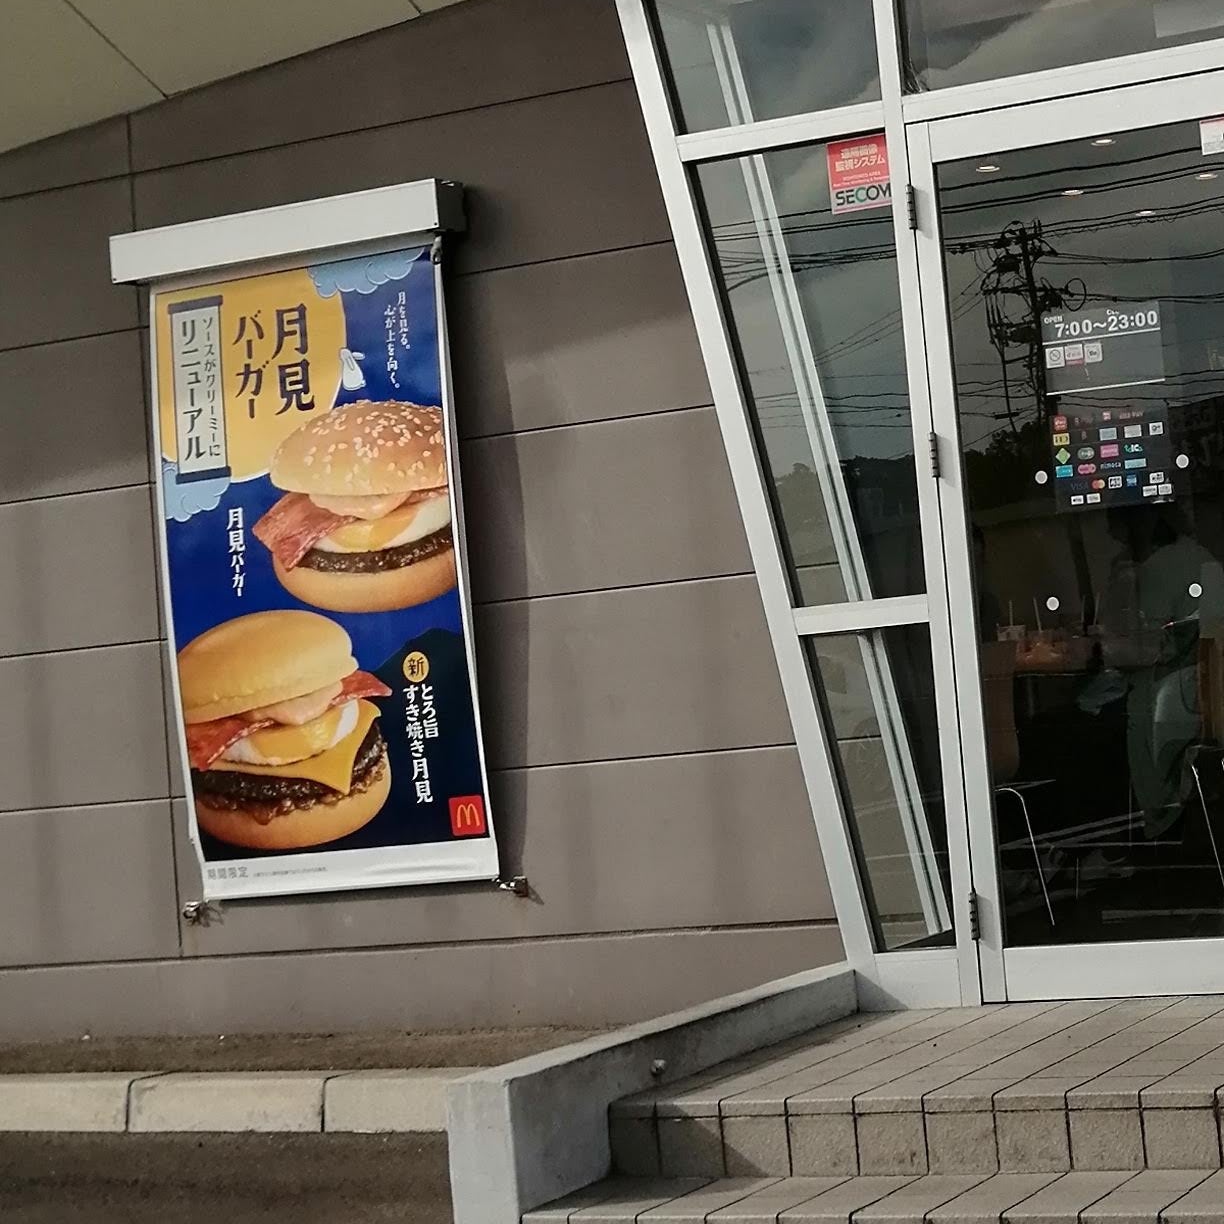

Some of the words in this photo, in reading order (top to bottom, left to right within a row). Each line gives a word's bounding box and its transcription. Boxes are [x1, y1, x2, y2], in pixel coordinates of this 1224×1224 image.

[835, 182, 892, 207] SECOM
[271, 303, 315, 416] 月見
[384, 304, 401, 389] 心が上を向く。
[398, 291, 411, 350] 月を見る。
[1043, 315, 1063, 324] OPEN
[180, 319, 207, 461] リニューアル
[202, 316, 221, 457] ソースがクリーミーに
[232, 309, 270, 419] バーガー
[226, 507, 247, 597] 月見バーガー
[407, 656, 425, 677] 新
[402, 684, 433, 804] すき焼き月見
[421, 683, 439, 739] とろ旨
